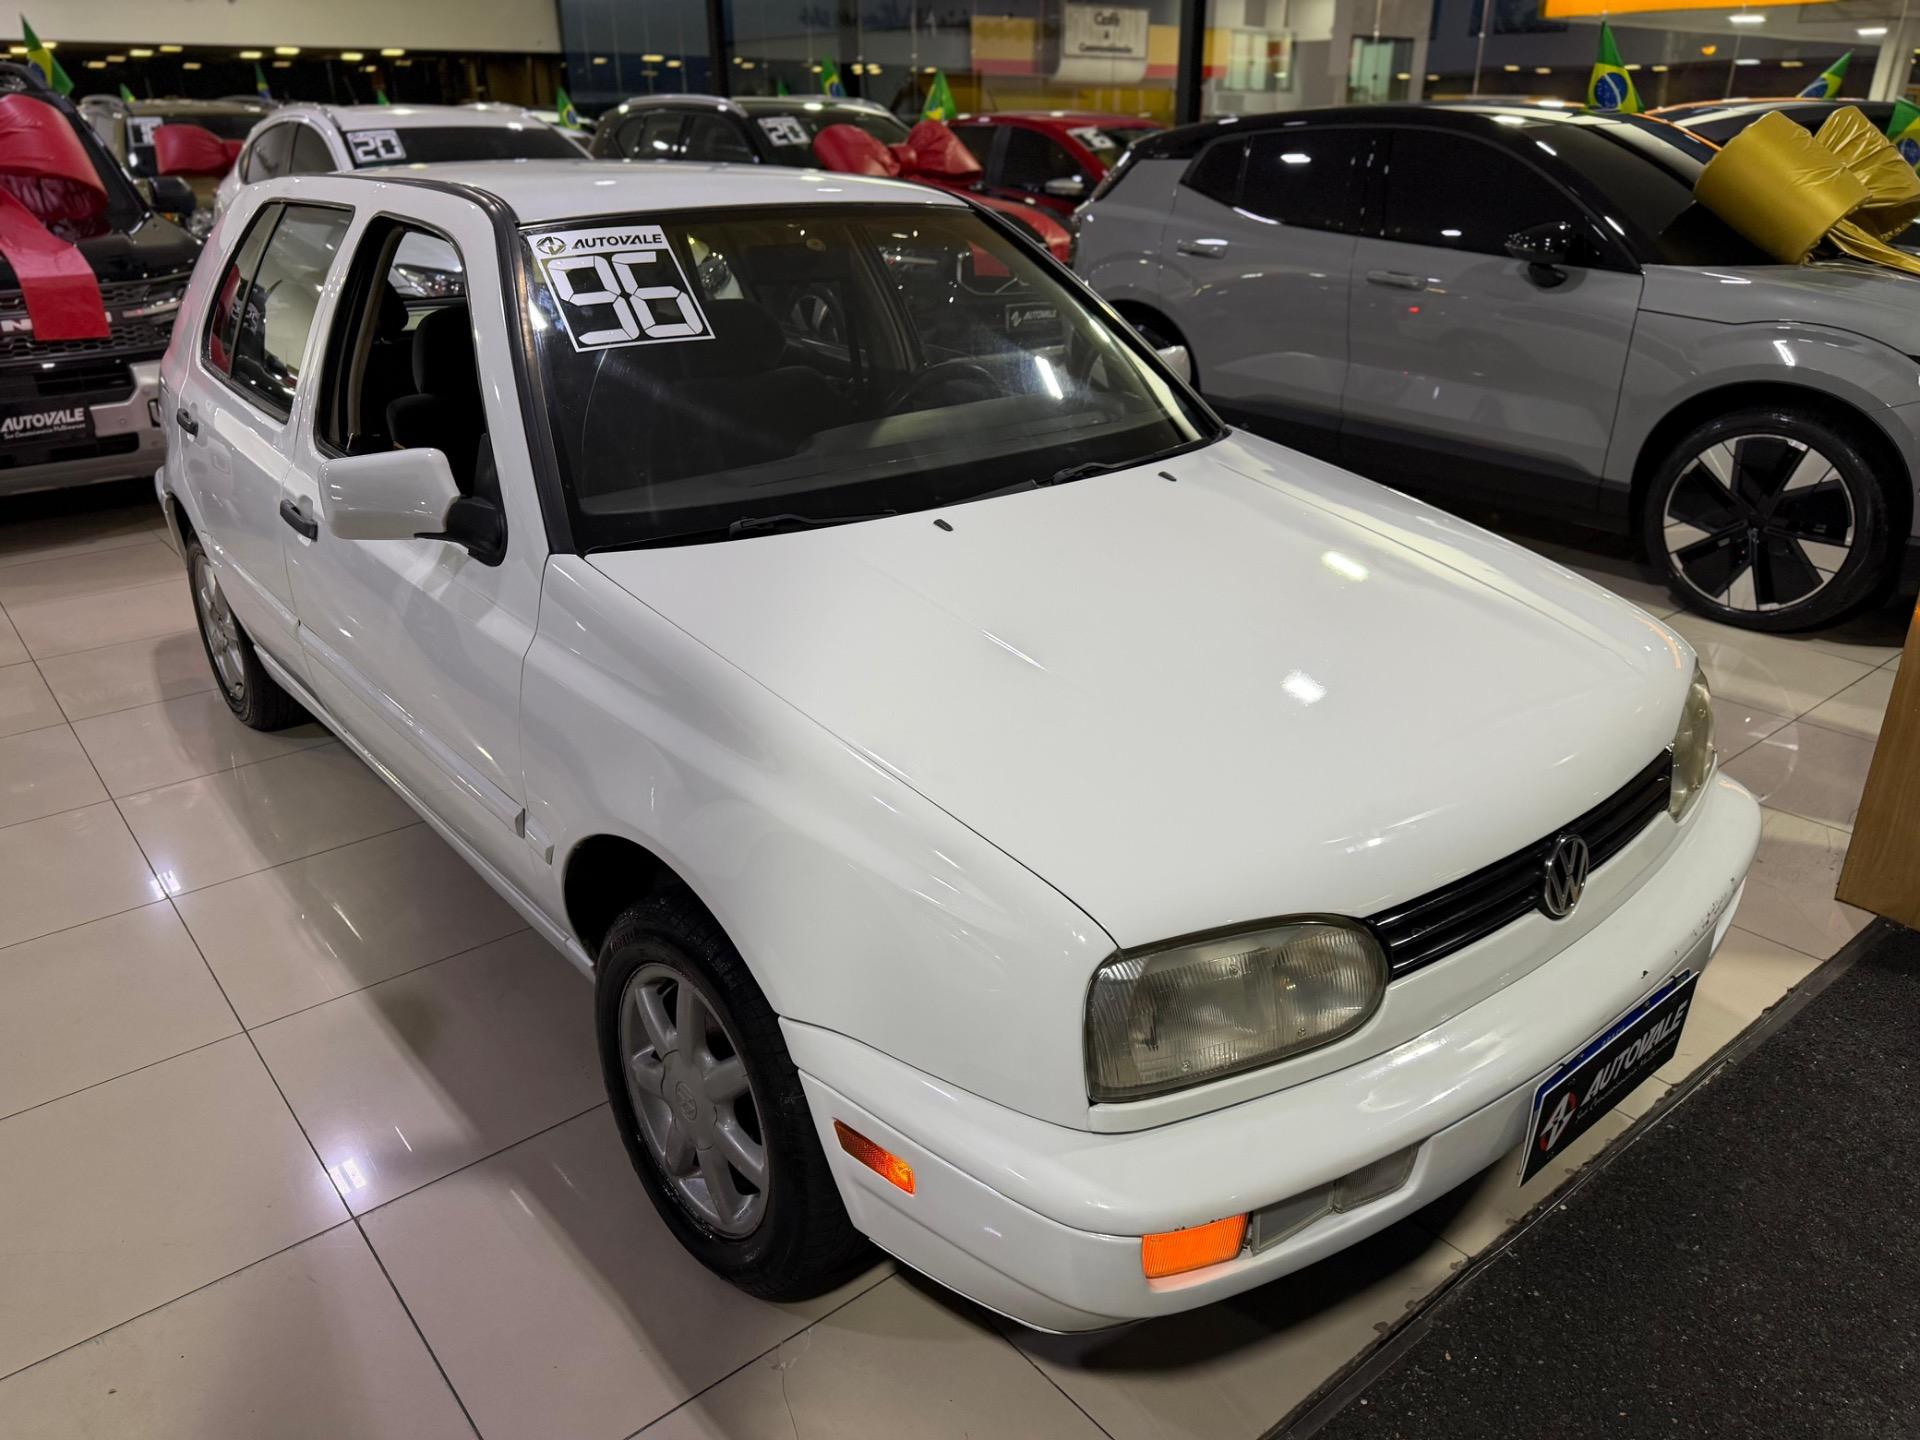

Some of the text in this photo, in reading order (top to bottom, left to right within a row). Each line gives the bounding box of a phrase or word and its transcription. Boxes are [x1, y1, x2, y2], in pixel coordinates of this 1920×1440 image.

[762, 123, 808, 145] 20
[352, 136, 402, 161] 20
[572, 233, 663, 250] AUTOVALE
[547, 251, 703, 345] 96
[0, 408, 85, 432] AUTOVALE
[1580, 1000, 1689, 1108] AUTOVALE
